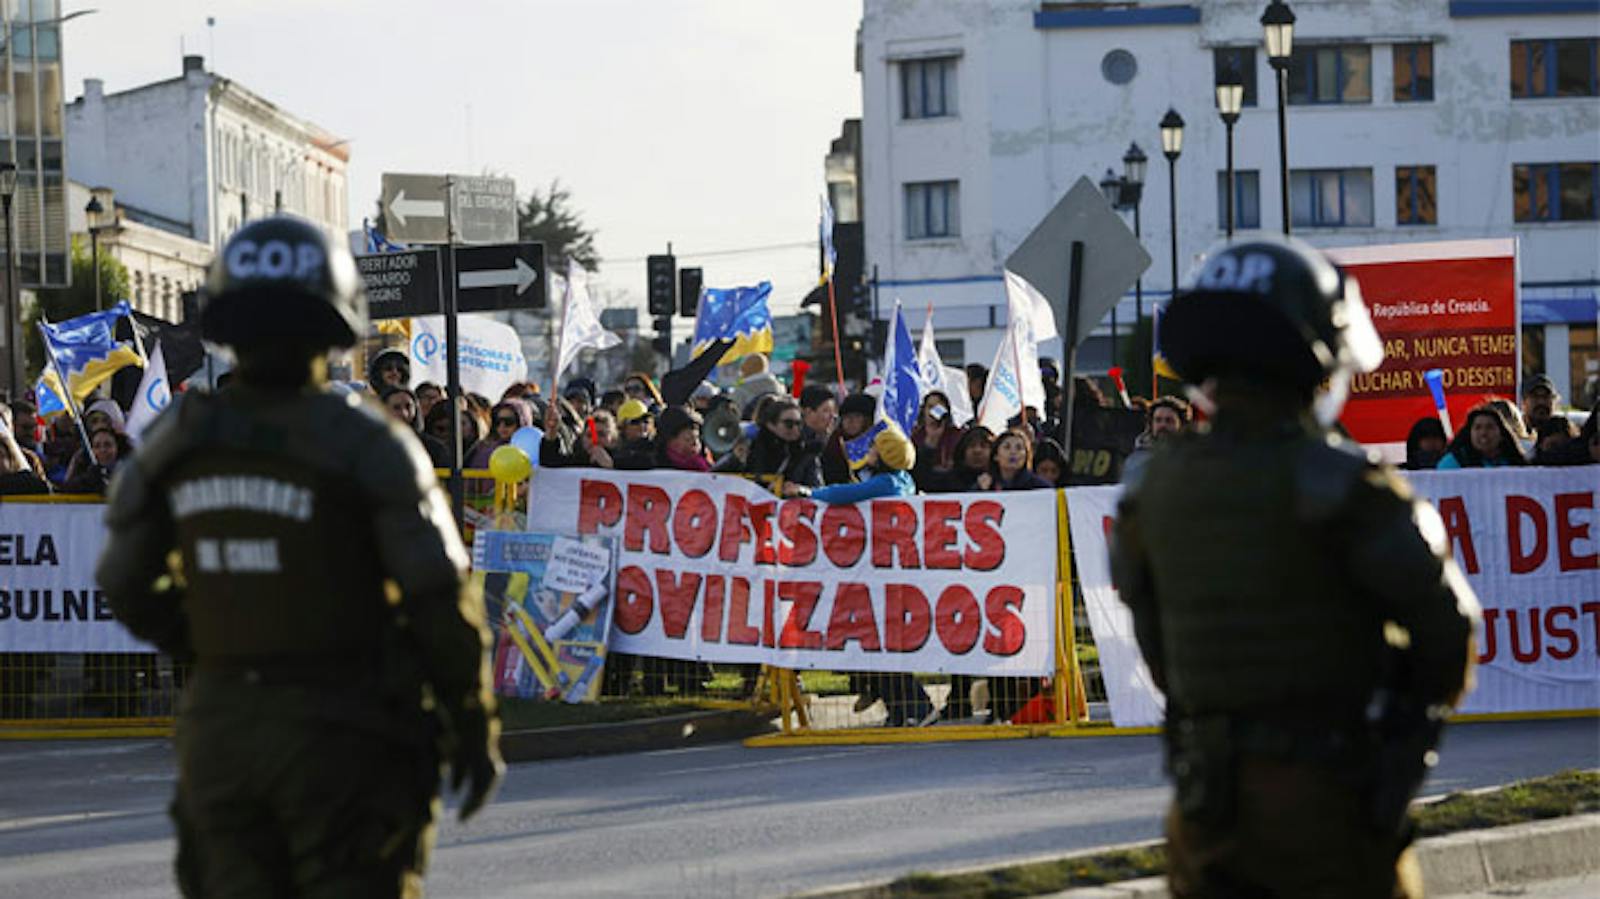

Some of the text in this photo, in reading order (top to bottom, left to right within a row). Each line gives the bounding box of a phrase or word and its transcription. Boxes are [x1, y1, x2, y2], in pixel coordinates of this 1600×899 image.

[359, 254, 418, 271] BERTADOR
[1374, 301, 1430, 318] República
[1432, 301, 1446, 315] de
[1384, 338, 1410, 359] AR,
[1414, 336, 1469, 357] NUNCA
[1352, 369, 1411, 392] LUCHAR
[1457, 365, 1514, 387] DESISTIR
[577, 478, 1006, 572] PROFESORES
[1439, 495, 1480, 574] A
[0, 534, 59, 566] ELA
[616, 564, 1026, 655] OVILIZADOS
